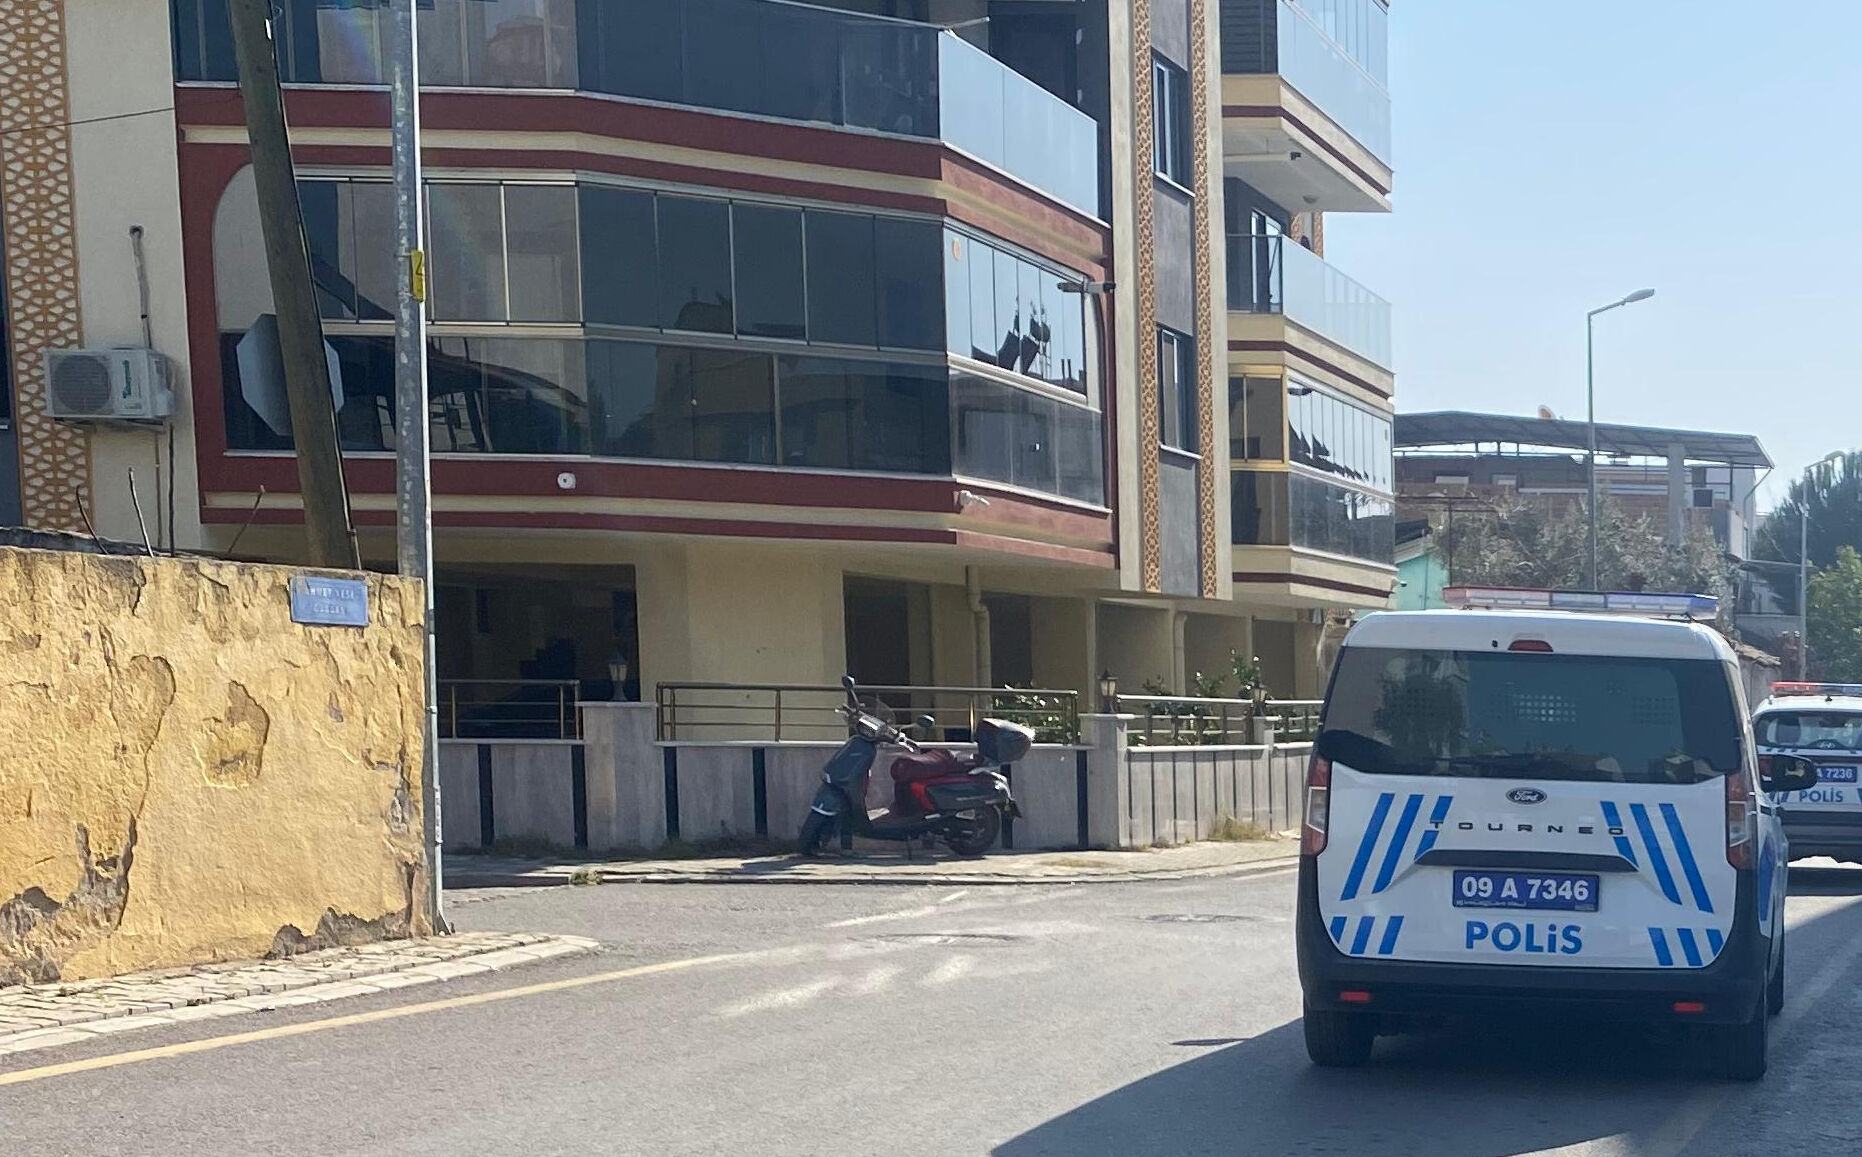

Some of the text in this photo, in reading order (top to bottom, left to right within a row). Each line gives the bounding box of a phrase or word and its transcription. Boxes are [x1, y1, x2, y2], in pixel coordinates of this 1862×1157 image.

[1430, 820, 1624, 836] TOURNEO
[1462, 876, 1588, 901] 09 A 7346
